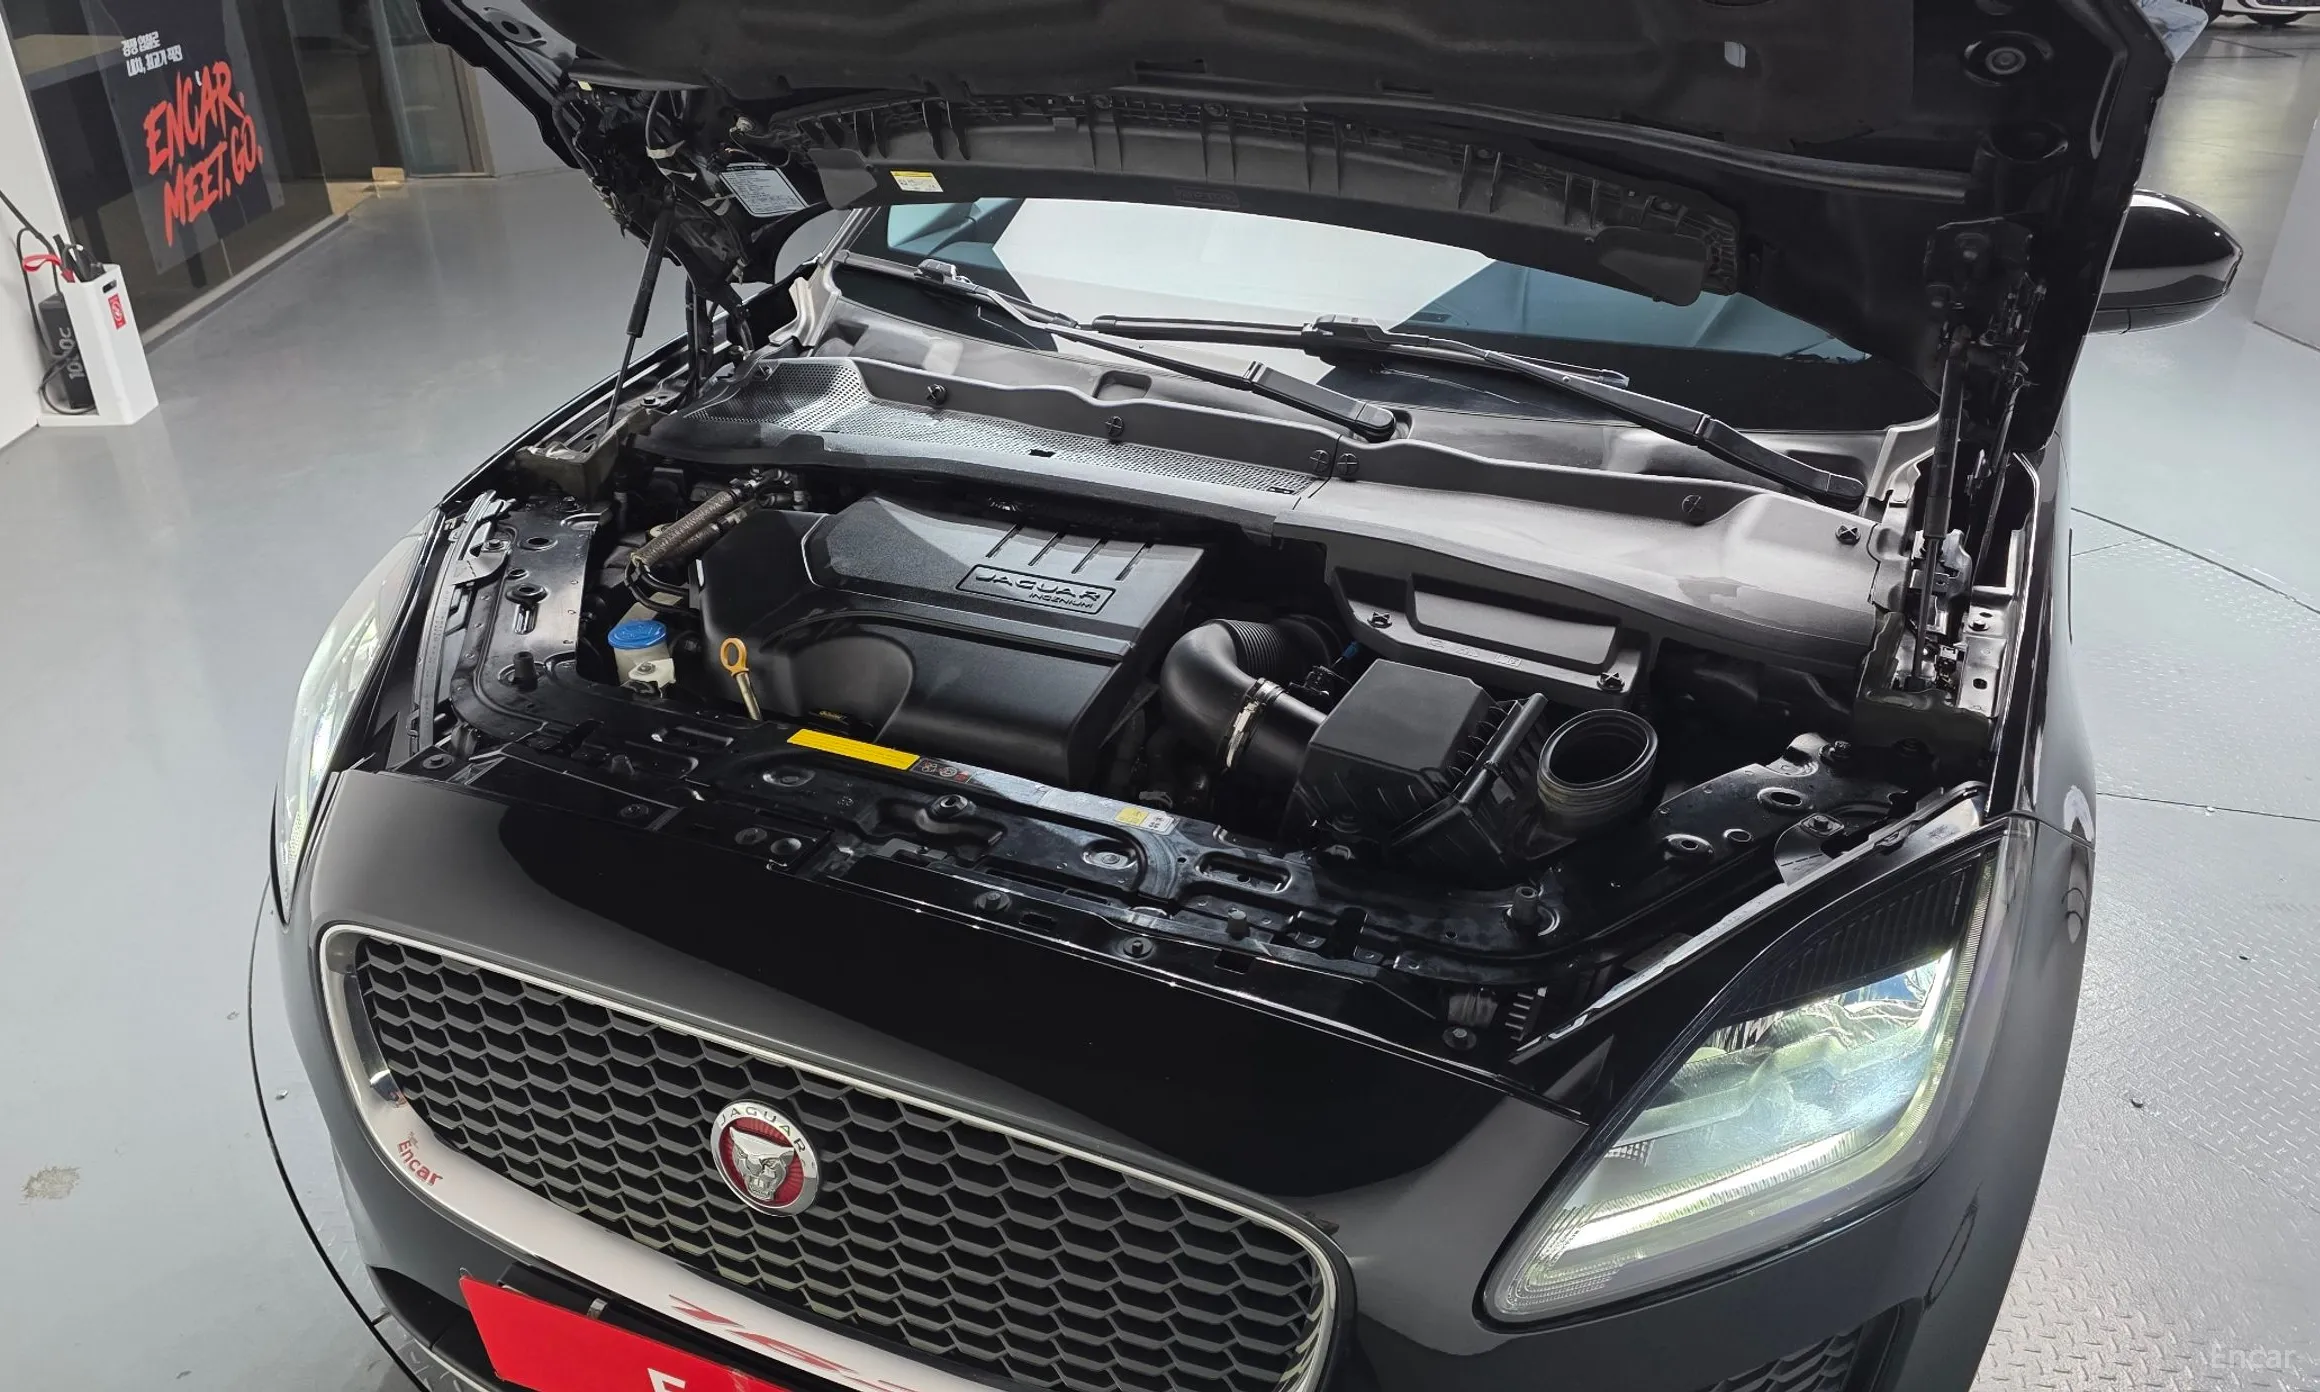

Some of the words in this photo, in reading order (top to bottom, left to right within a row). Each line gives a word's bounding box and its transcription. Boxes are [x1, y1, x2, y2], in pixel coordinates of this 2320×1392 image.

[975, 574, 1101, 602] JAGUAR
[1028, 593, 1095, 609] INGENIUM
[720, 1106, 806, 1153] JAGUAR
[397, 1139, 444, 1186] Encar
